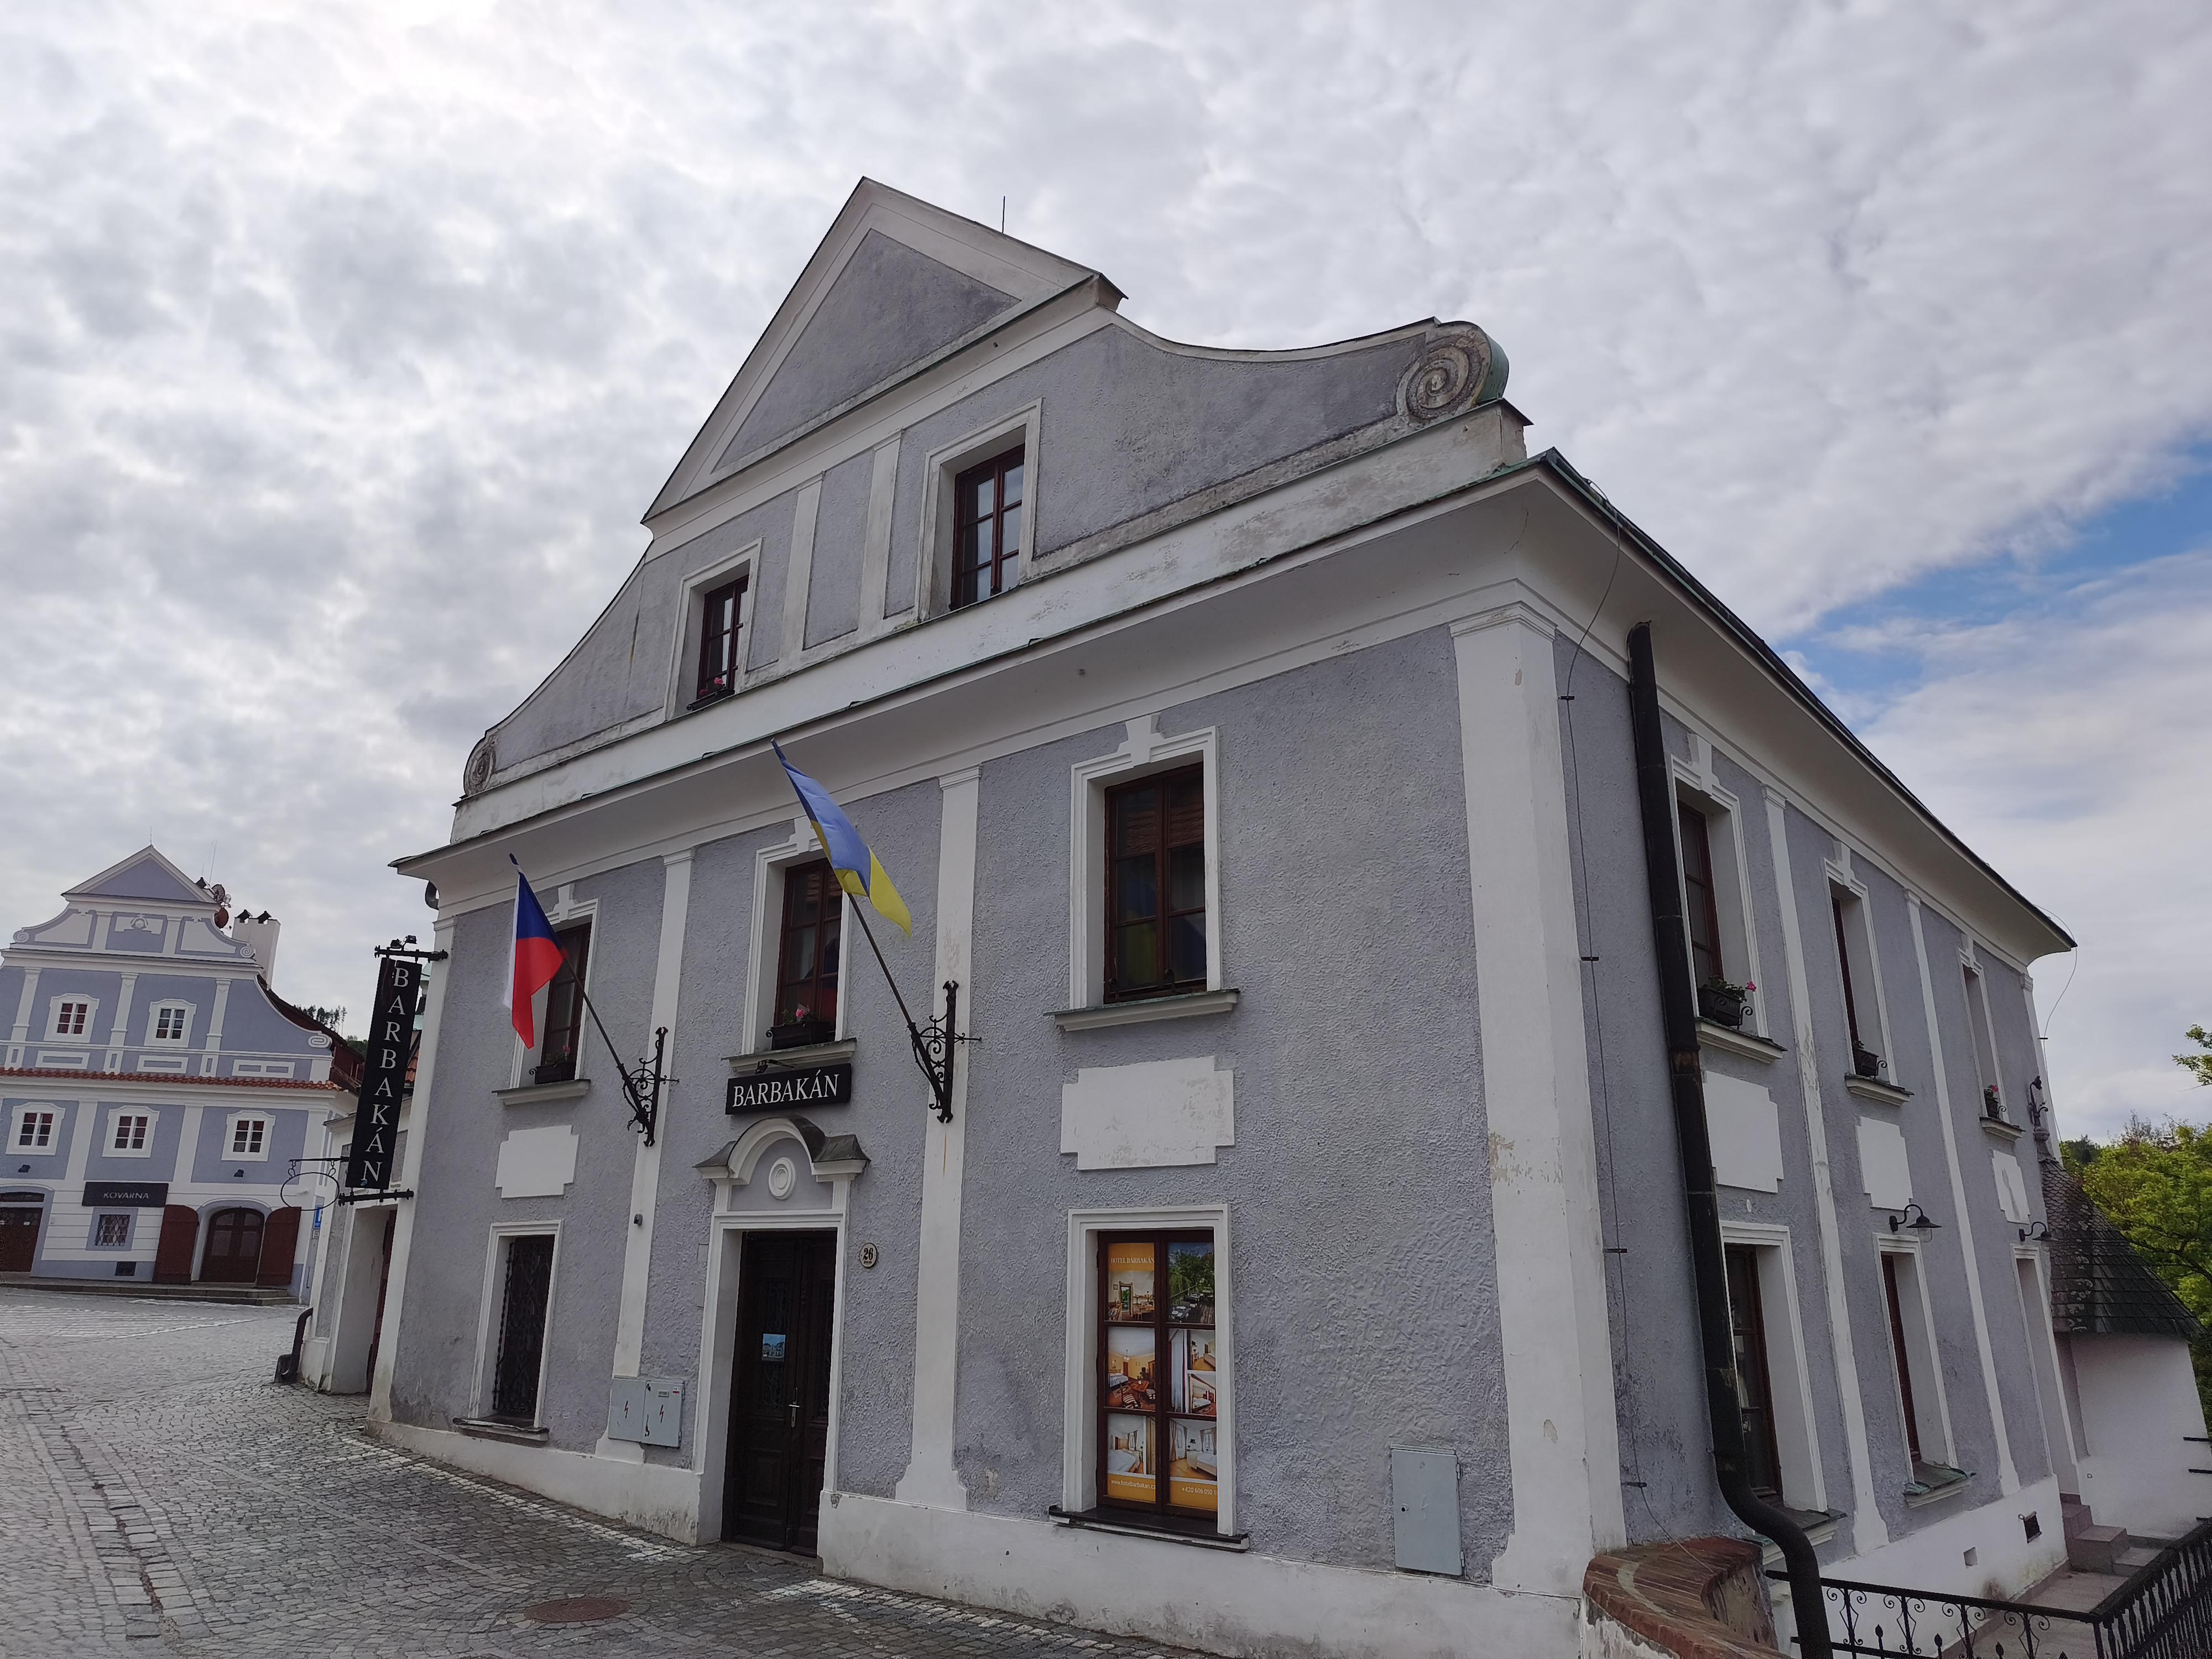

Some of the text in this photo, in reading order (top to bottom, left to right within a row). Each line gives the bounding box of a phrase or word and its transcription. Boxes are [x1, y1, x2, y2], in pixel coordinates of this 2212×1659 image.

[361, 967, 410, 1183] BARBAKÁN
[732, 1070, 839, 1108] BARBAKÁN
[863, 1248, 873, 1260] 26
